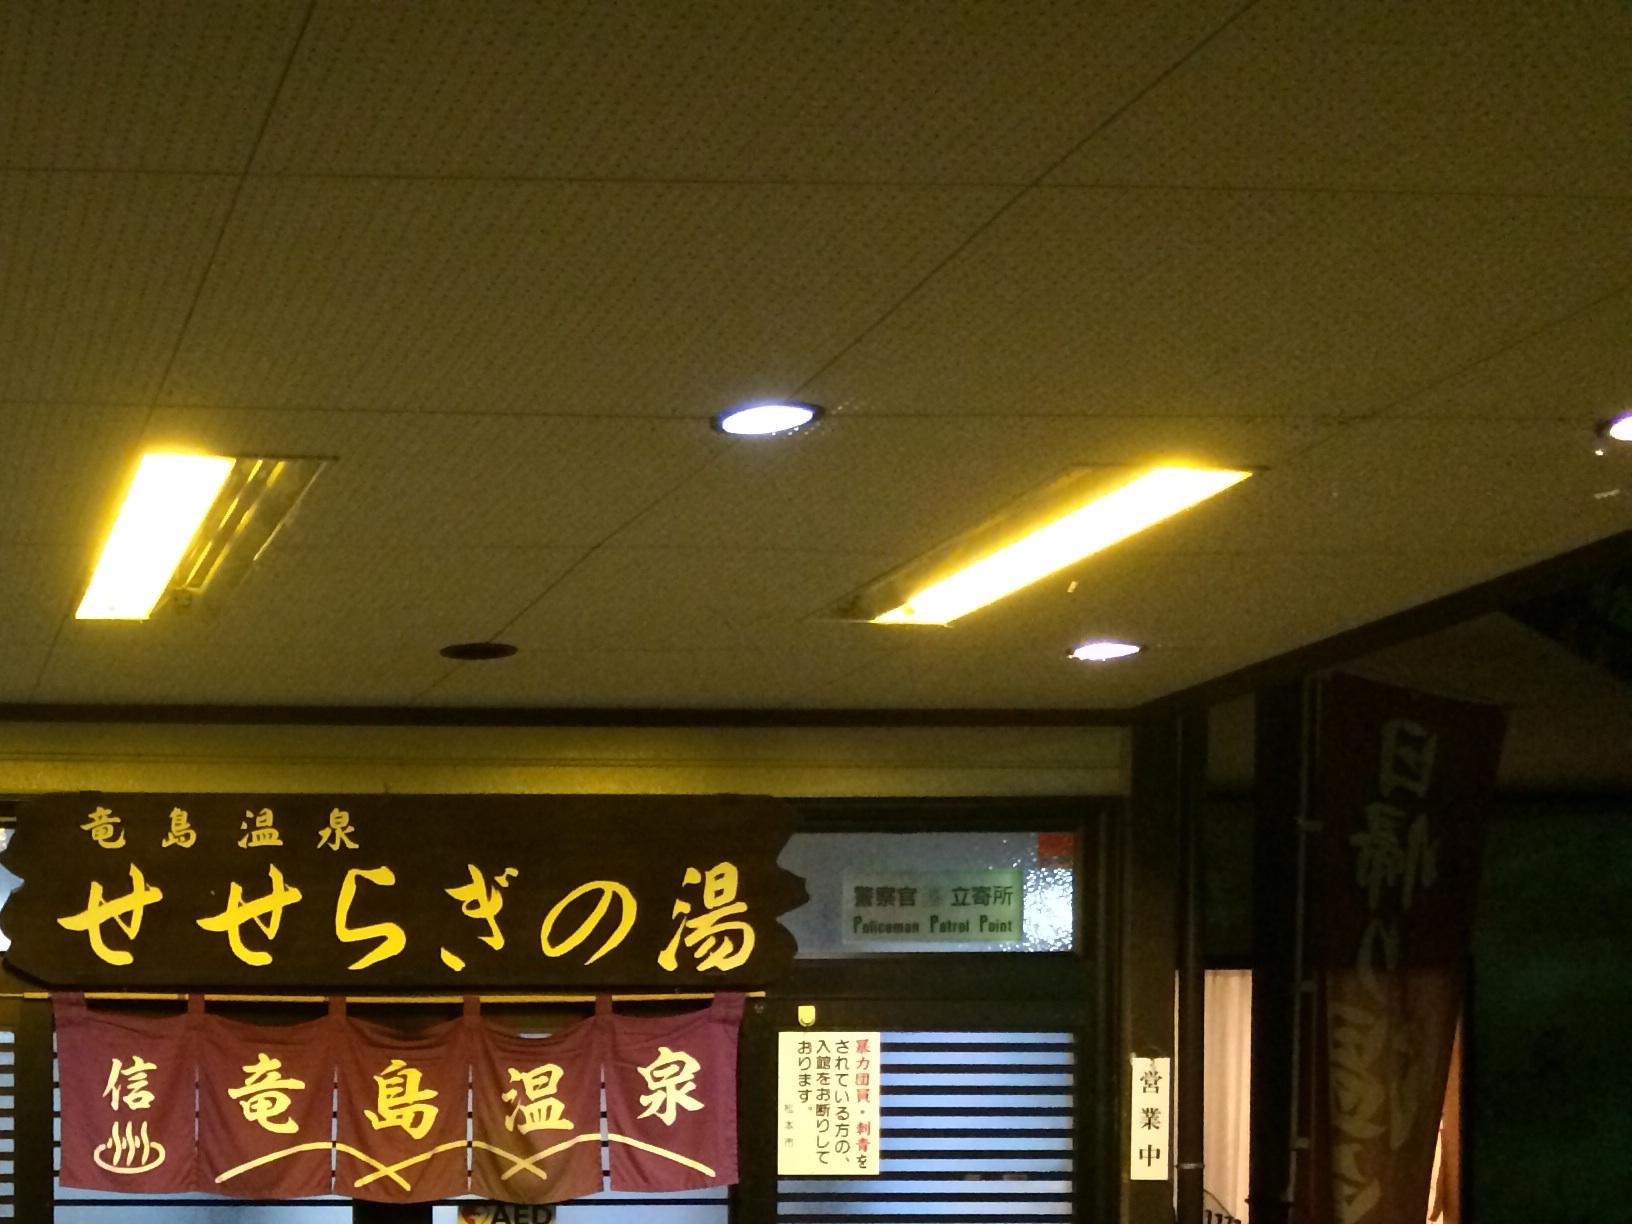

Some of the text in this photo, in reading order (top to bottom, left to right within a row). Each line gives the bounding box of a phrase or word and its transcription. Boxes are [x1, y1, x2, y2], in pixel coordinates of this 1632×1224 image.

[80, 806, 361, 850] 竜島温泉
[56, 861, 757, 973] せせらぎの湯
[852, 914, 1013, 934] Policeman Patrol Point
[797, 1040, 813, 1112] おります。
[815, 1039, 832, 1165] 入館をお断りして
[834, 1039, 851, 1163] されている方の、
[1139, 1070, 1164, 1168] 営業中
